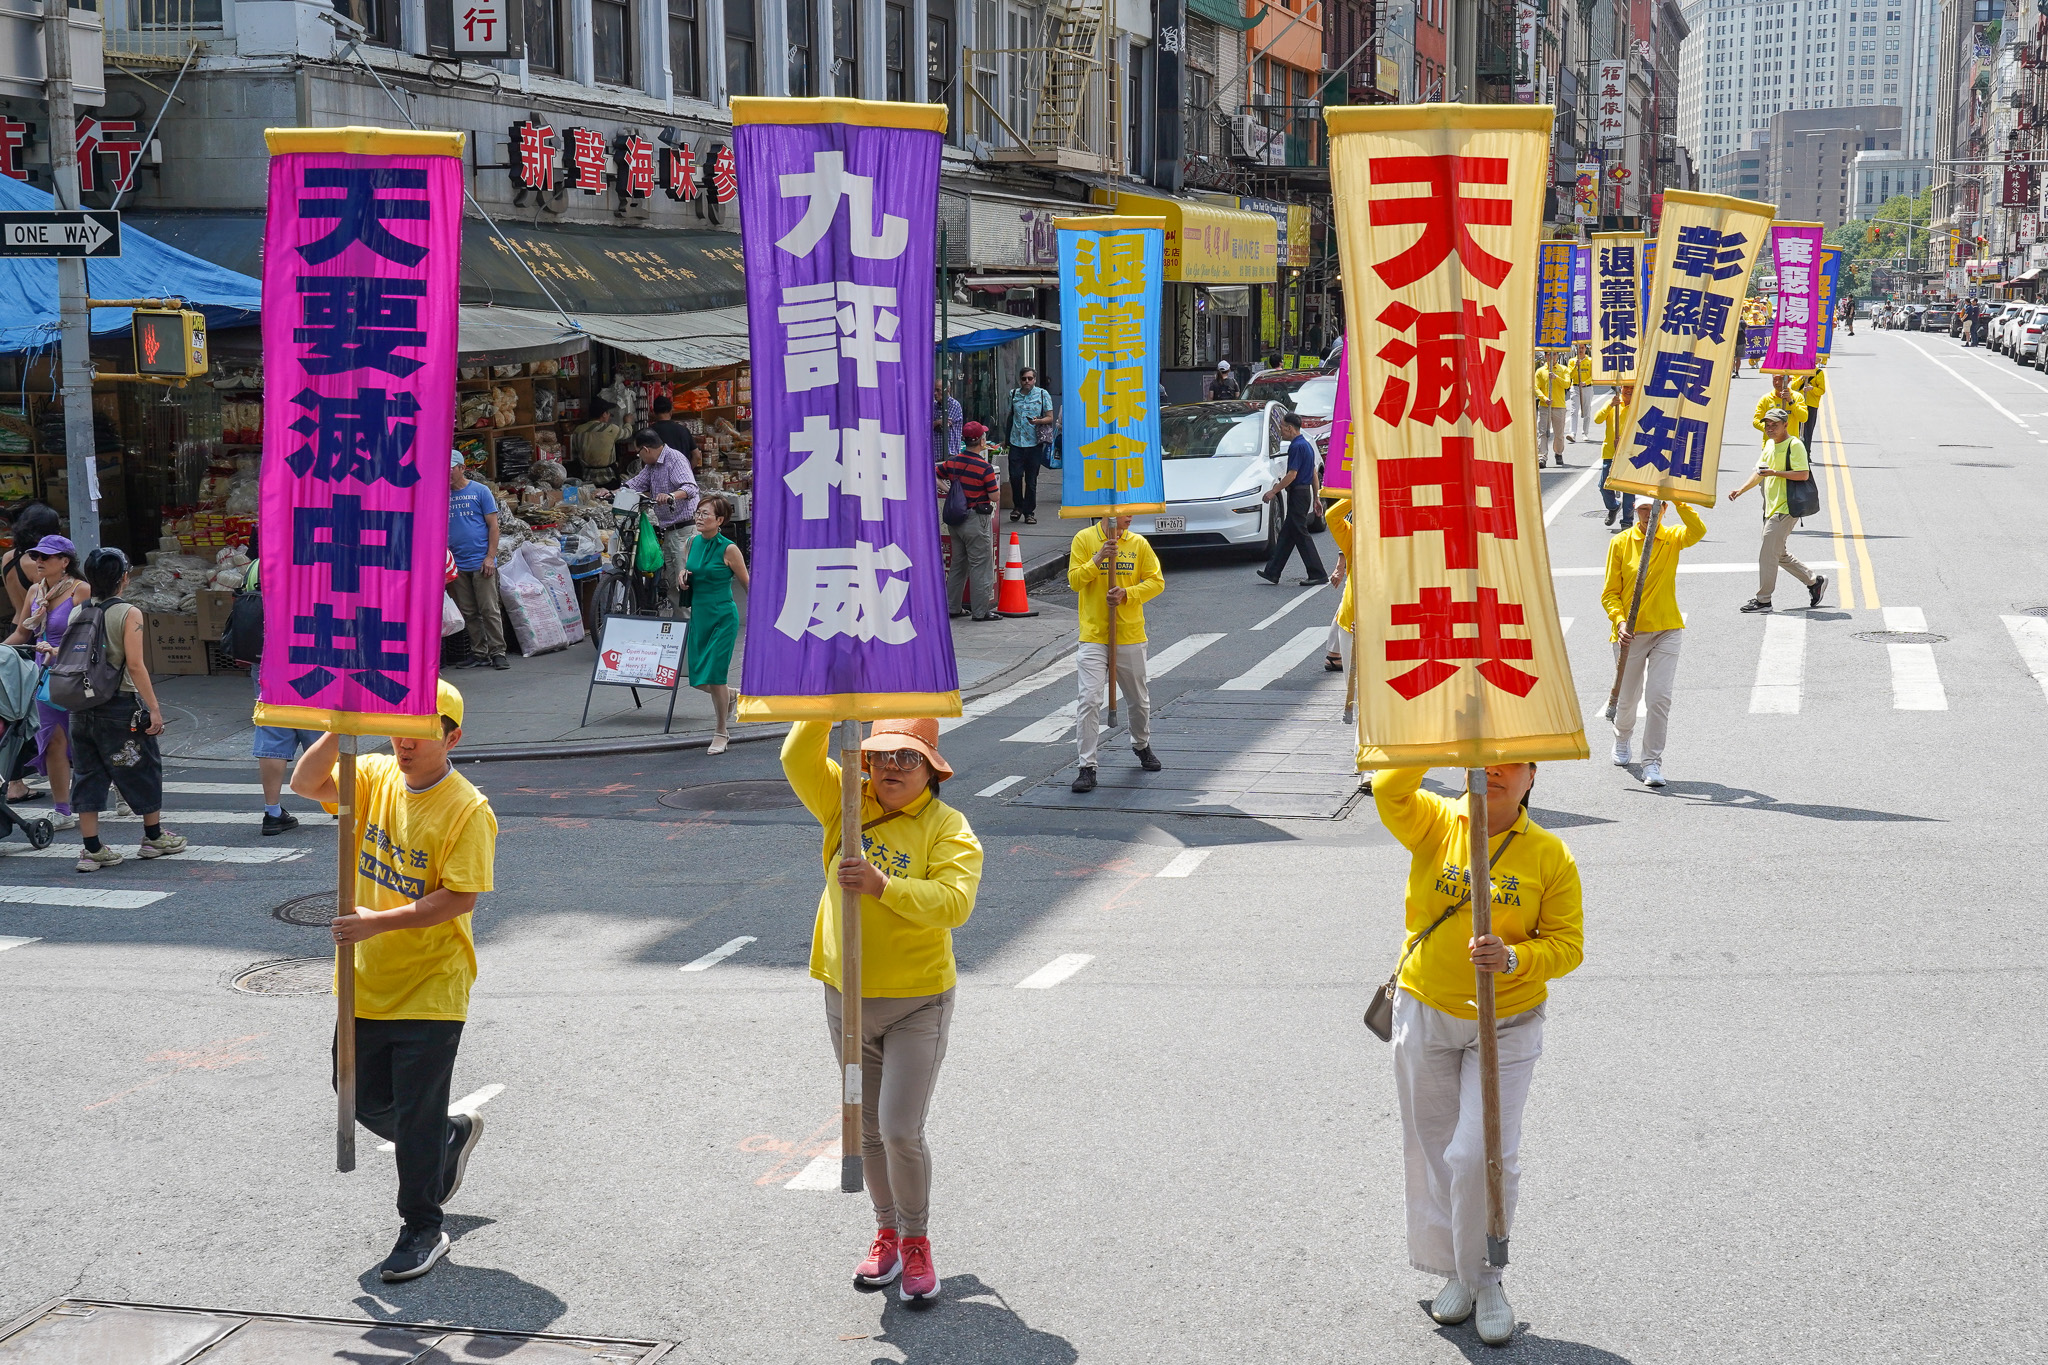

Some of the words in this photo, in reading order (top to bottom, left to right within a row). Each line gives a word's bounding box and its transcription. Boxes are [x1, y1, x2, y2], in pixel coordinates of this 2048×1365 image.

[1600, 66, 1624, 132] 福華傢俬
[14, 226, 48, 243] ONE
[64, 226, 100, 243] WAY
[1539, 246, 1570, 344] 擺脫中共暴政
[1599, 246, 1637, 372] 退黨保命
[774, 150, 917, 645] 九評神威
[1074, 234, 1148, 492] 退黨保命
[1628, 225, 1748, 482] 彰顯良知
[284, 167, 430, 706] 天要滅中共
[1369, 155, 1540, 701] 天滅中共
[364, 821, 428, 870] 法輪大法
[862, 834, 910, 870] 輪大法
[1435, 879, 1472, 900] FALU
[1492, 892, 1521, 906] AFA
